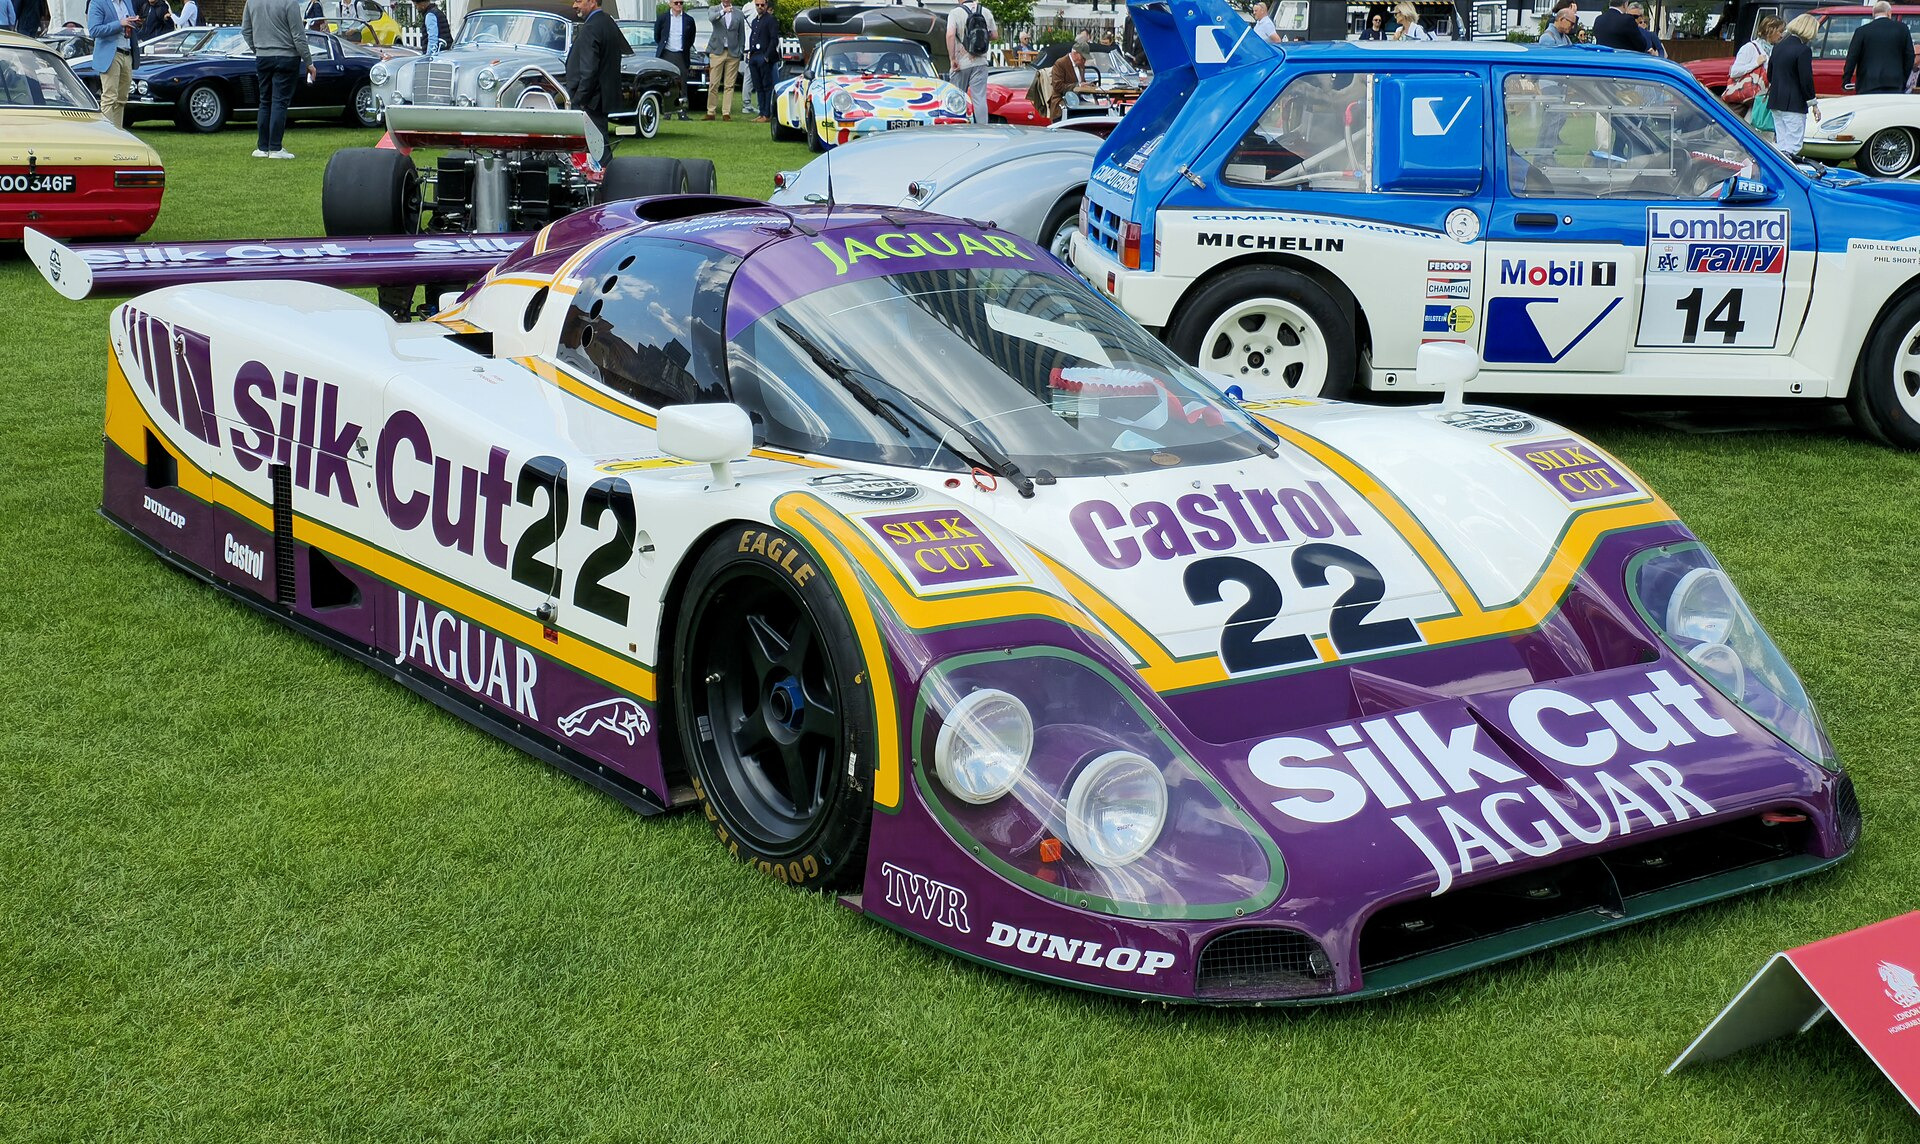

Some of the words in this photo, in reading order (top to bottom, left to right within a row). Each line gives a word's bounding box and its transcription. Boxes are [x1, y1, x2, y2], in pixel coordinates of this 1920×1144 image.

[0, 175, 28, 191] OO
[30, 175, 73, 191] 346F
[1738, 181, 1764, 193] RED
[1192, 214, 1442, 240] COMPUTERVISION
[1196, 232, 1344, 252] MICHELIN
[1652, 212, 1785, 240] Lombard
[77, 247, 215, 264] Silk
[225, 242, 351, 259] Cut
[812, 233, 1035, 276] JAGUAR
[1687, 244, 1782, 273] rally
[1876, 244, 1917, 252] LLEWELLIN
[1429, 262, 1468, 271] FERODO
[1500, 260, 1583, 287] Mobil
[1594, 261, 1614, 287] 1
[1428, 285, 1469, 293] CHAMPION
[1676, 288, 1745, 344] 14
[1524, 440, 1600, 473] SILK
[230, 360, 363, 508] Silk
[375, 410, 512, 570] Cut
[511, 455, 637, 627] 22
[1558, 466, 1622, 494] CUT
[143, 495, 186, 529] DUNLOP
[1069, 481, 1362, 570] Castrol
[882, 517, 979, 545] SILK
[224, 532, 264, 581] Castrol
[738, 530, 816, 587] EAGLE
[914, 542, 995, 574] CUT
[1182, 543, 1422, 675] 22
[395, 591, 540, 722] JAGUAR
[1247, 707, 1528, 823] Silk
[1508, 670, 1737, 767] Cut
[1391, 760, 1717, 897] JAGUAR
[882, 862, 971, 933] TWR
[986, 921, 1175, 976] DUNLOP
[1888, 1018, 1920, 1035] HONOURABL
